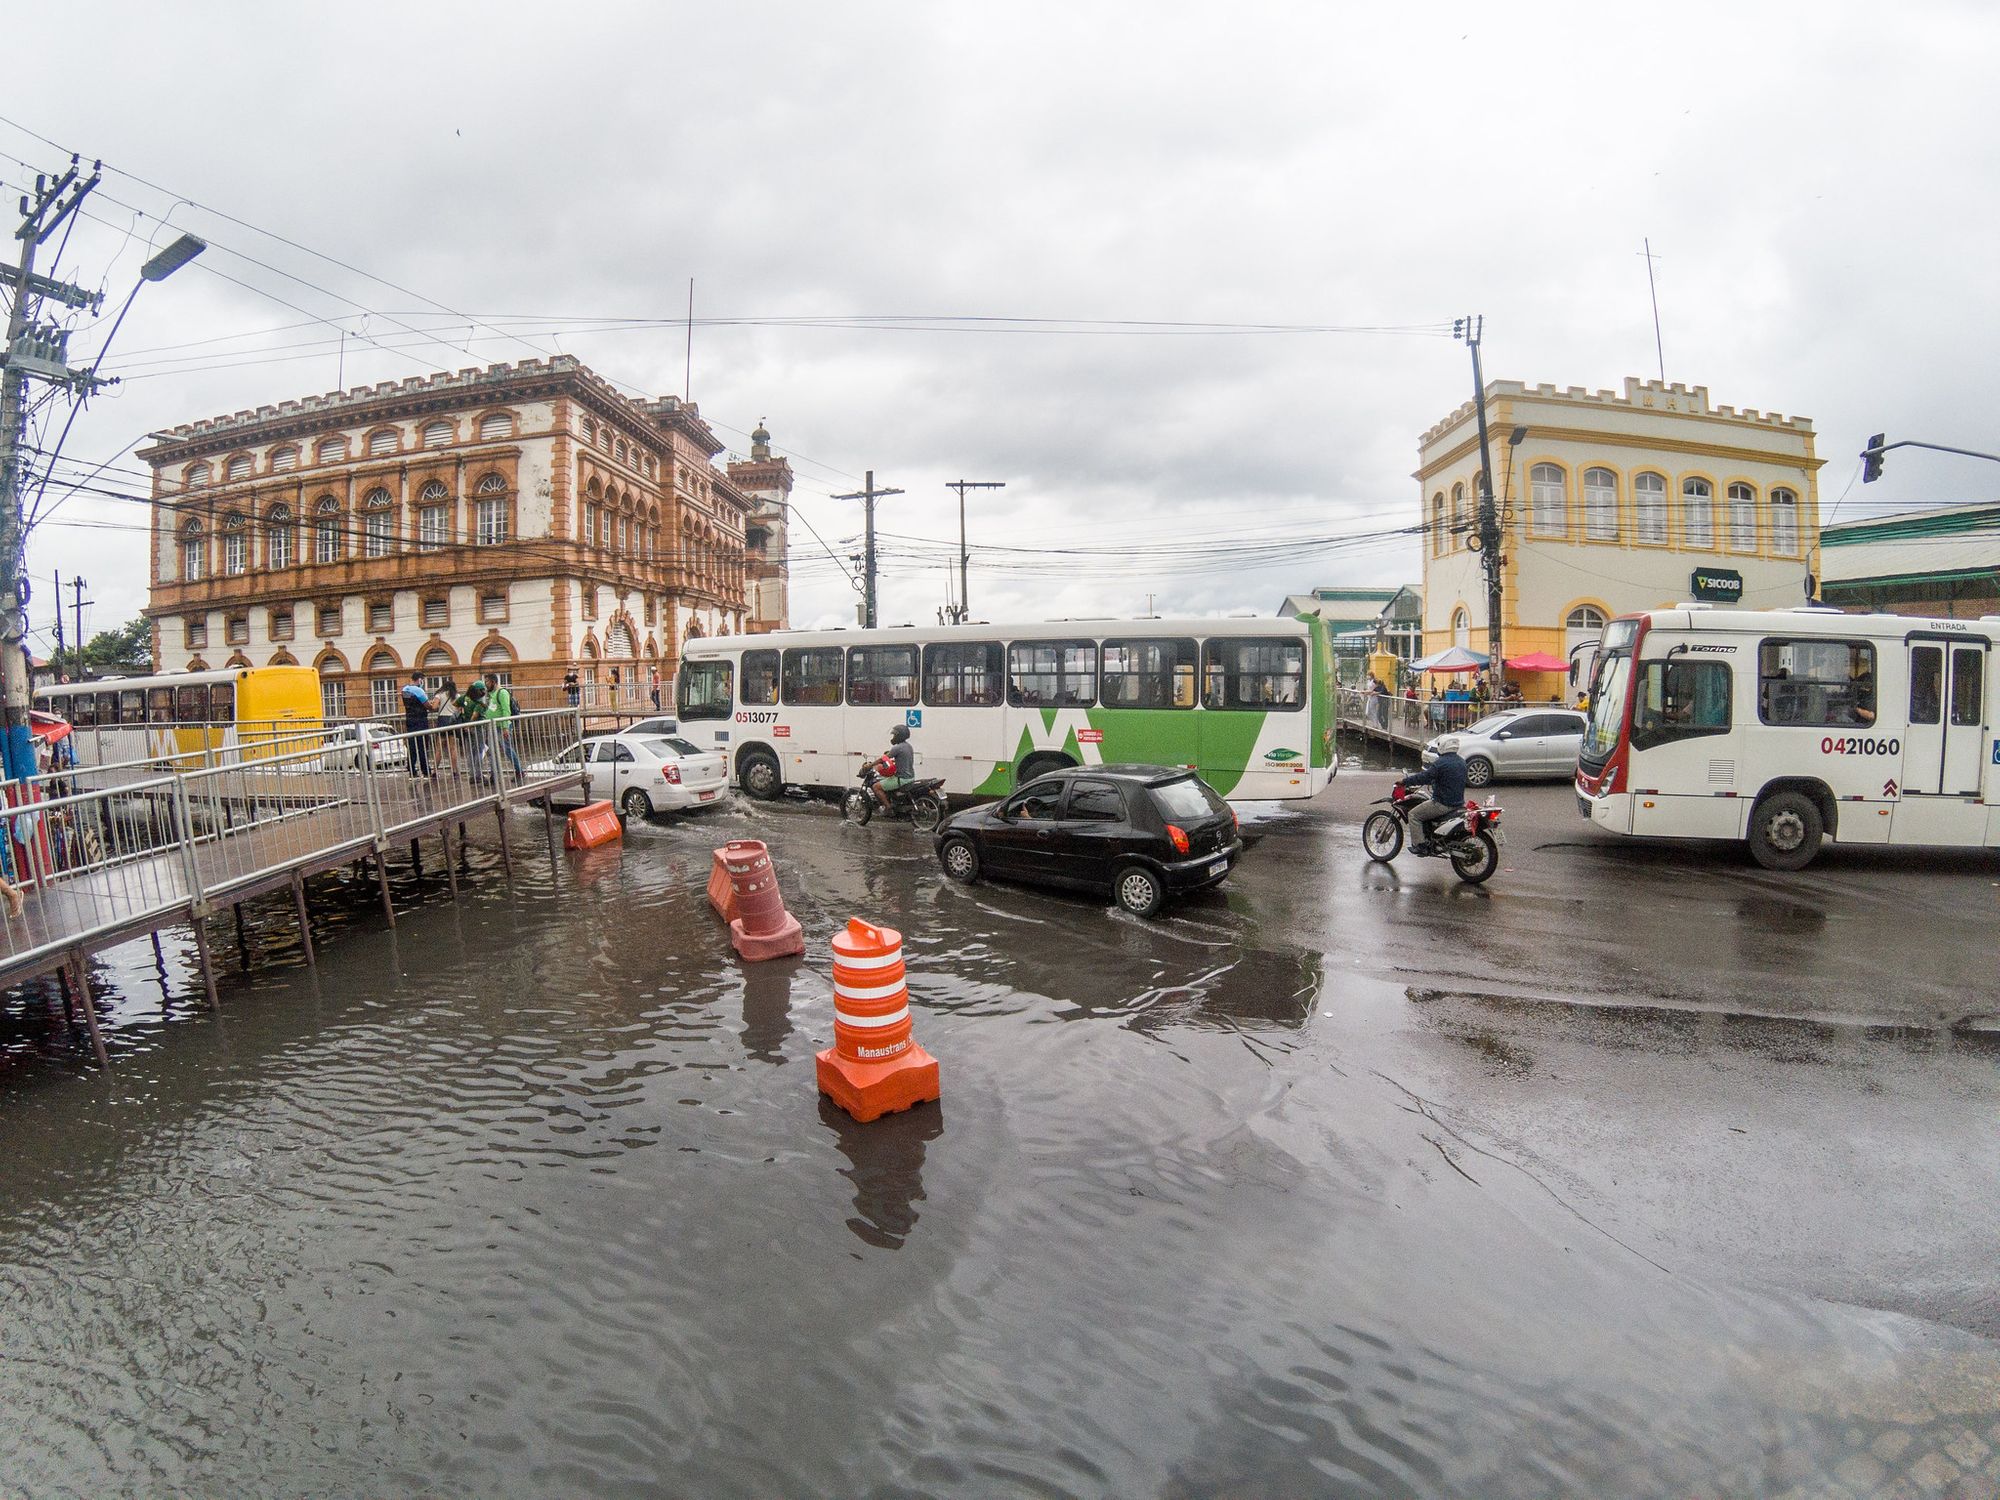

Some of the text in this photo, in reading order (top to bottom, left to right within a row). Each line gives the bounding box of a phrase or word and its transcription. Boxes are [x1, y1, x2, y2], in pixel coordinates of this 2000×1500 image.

[1707, 578, 1740, 590] SICOOB
[1930, 621, 1967, 631] ENTRADA
[1692, 645, 1737, 653] Torino
[736, 711, 778, 723] 0513077
[1821, 737, 1900, 755] 0421060
[857, 1040, 906, 1057] Manaustrans
